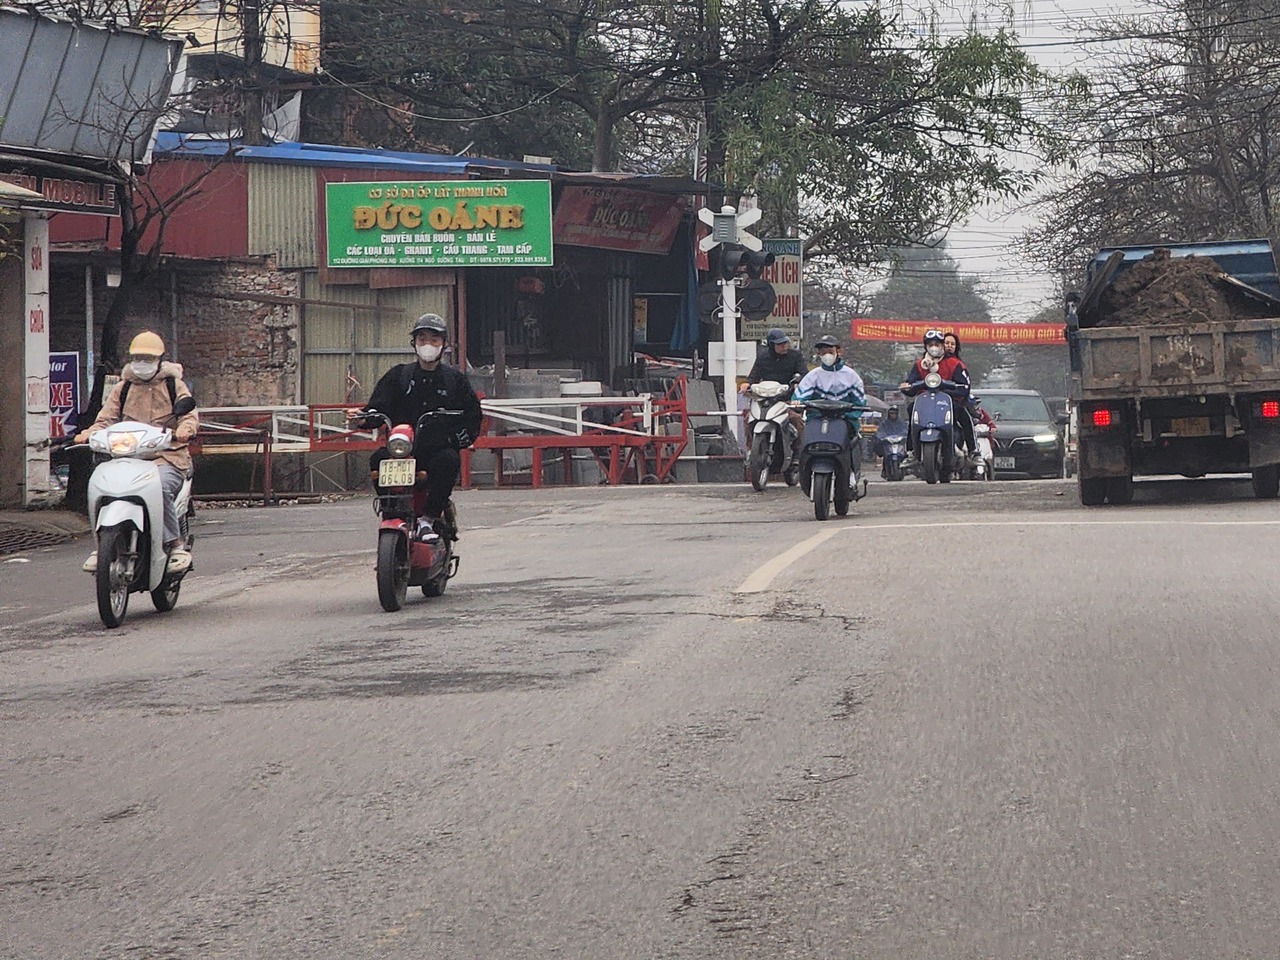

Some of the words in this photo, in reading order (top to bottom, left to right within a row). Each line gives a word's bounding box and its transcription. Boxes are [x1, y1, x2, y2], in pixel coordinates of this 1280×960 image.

[42, 177, 116, 208] MOBILE
[353, 201, 423, 230] ĐỨC
[781, 257, 799, 284] ÍCH
[959, 325, 990, 339] KHÔNG
[51, 382, 73, 407] XE
